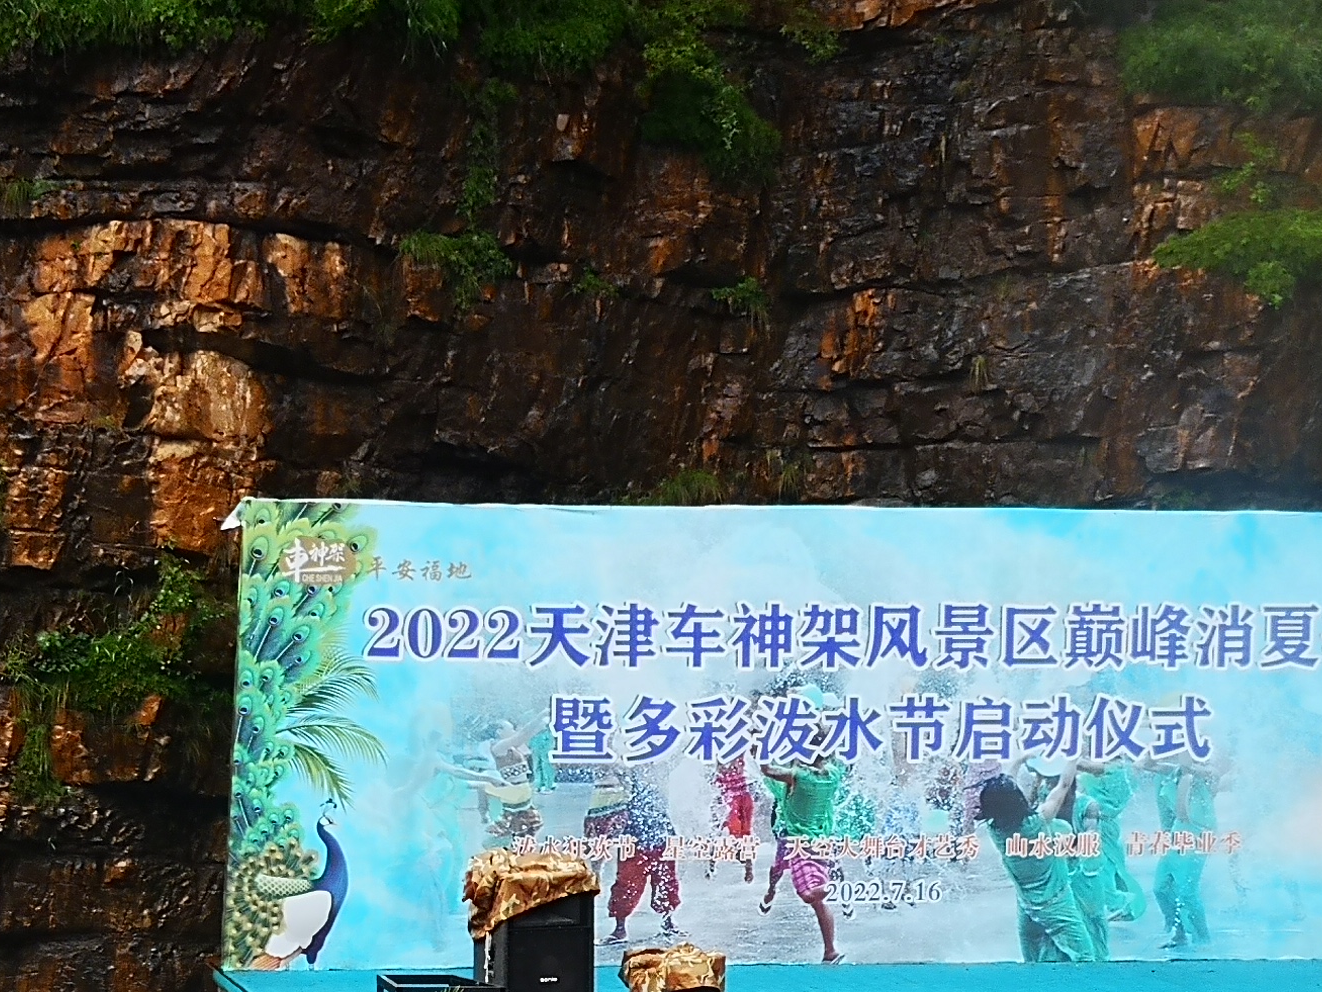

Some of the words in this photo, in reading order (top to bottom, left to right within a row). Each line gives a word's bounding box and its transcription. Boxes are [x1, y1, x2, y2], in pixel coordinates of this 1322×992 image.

[367, 556, 472, 581] 平安福地
[551, 695, 1211, 763] 暨多彩泼水节启动仪式
[662, 835, 761, 862] 星空露营
[784, 833, 980, 861] 天空大舞台才艺秀
[1005, 831, 1101, 859] 山水汉服
[1126, 830, 1244, 857] 青春毕业季
[825, 880, 942, 903] 2022.7.16
